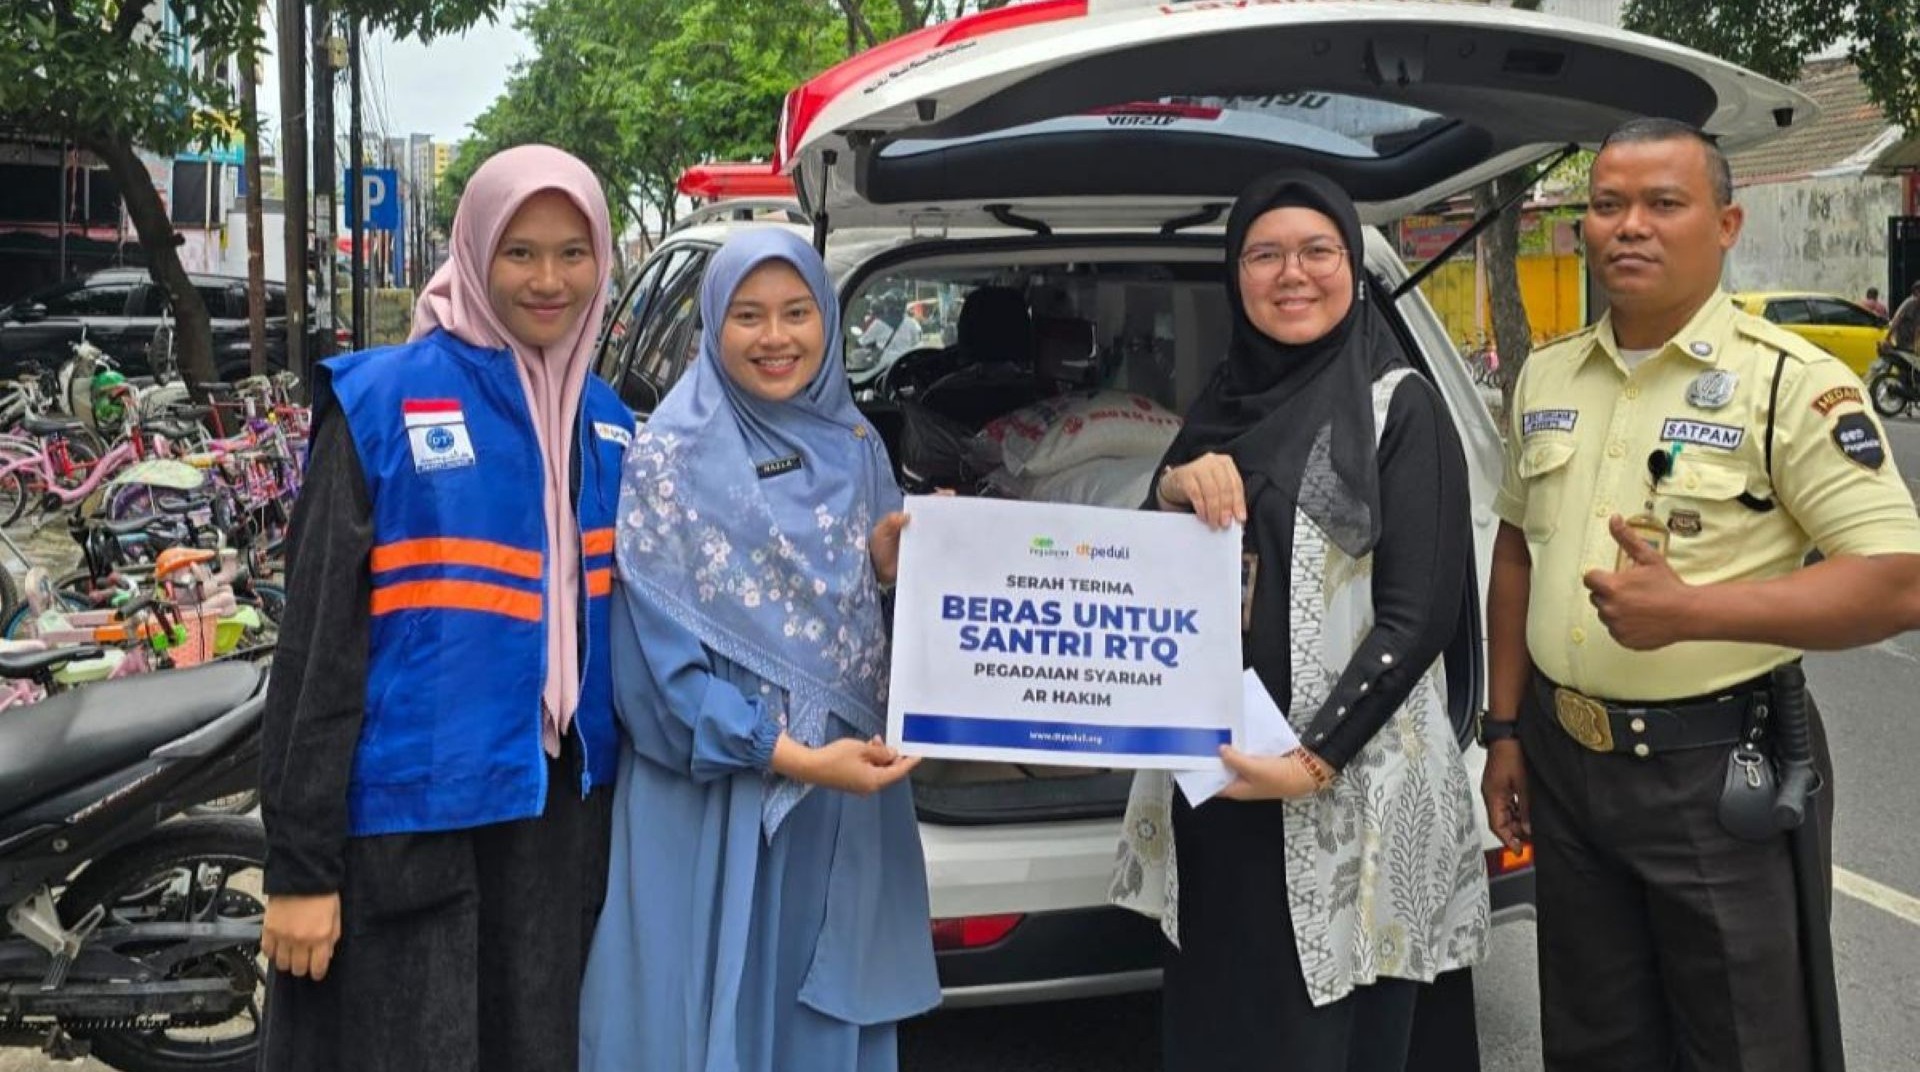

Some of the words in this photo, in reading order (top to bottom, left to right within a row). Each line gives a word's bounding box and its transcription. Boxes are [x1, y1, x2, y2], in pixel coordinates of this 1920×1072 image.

[362, 175, 386, 222] P
[1667, 423, 1738, 445] SATPAM
[1006, 575, 1065, 590] SERAH
[1069, 578, 1134, 596] TERIMA
[942, 595, 1062, 626] BERAS
[1073, 602, 1199, 635] UNTUK
[959, 625, 1092, 657] SANTRI
[1104, 633, 1179, 668] RTQ
[974, 662, 1079, 682] PEGADAIAN
[1083, 668, 1162, 686] SYARIAH
[1021, 688, 1047, 704] AR
[1052, 690, 1112, 707] HAKIM
